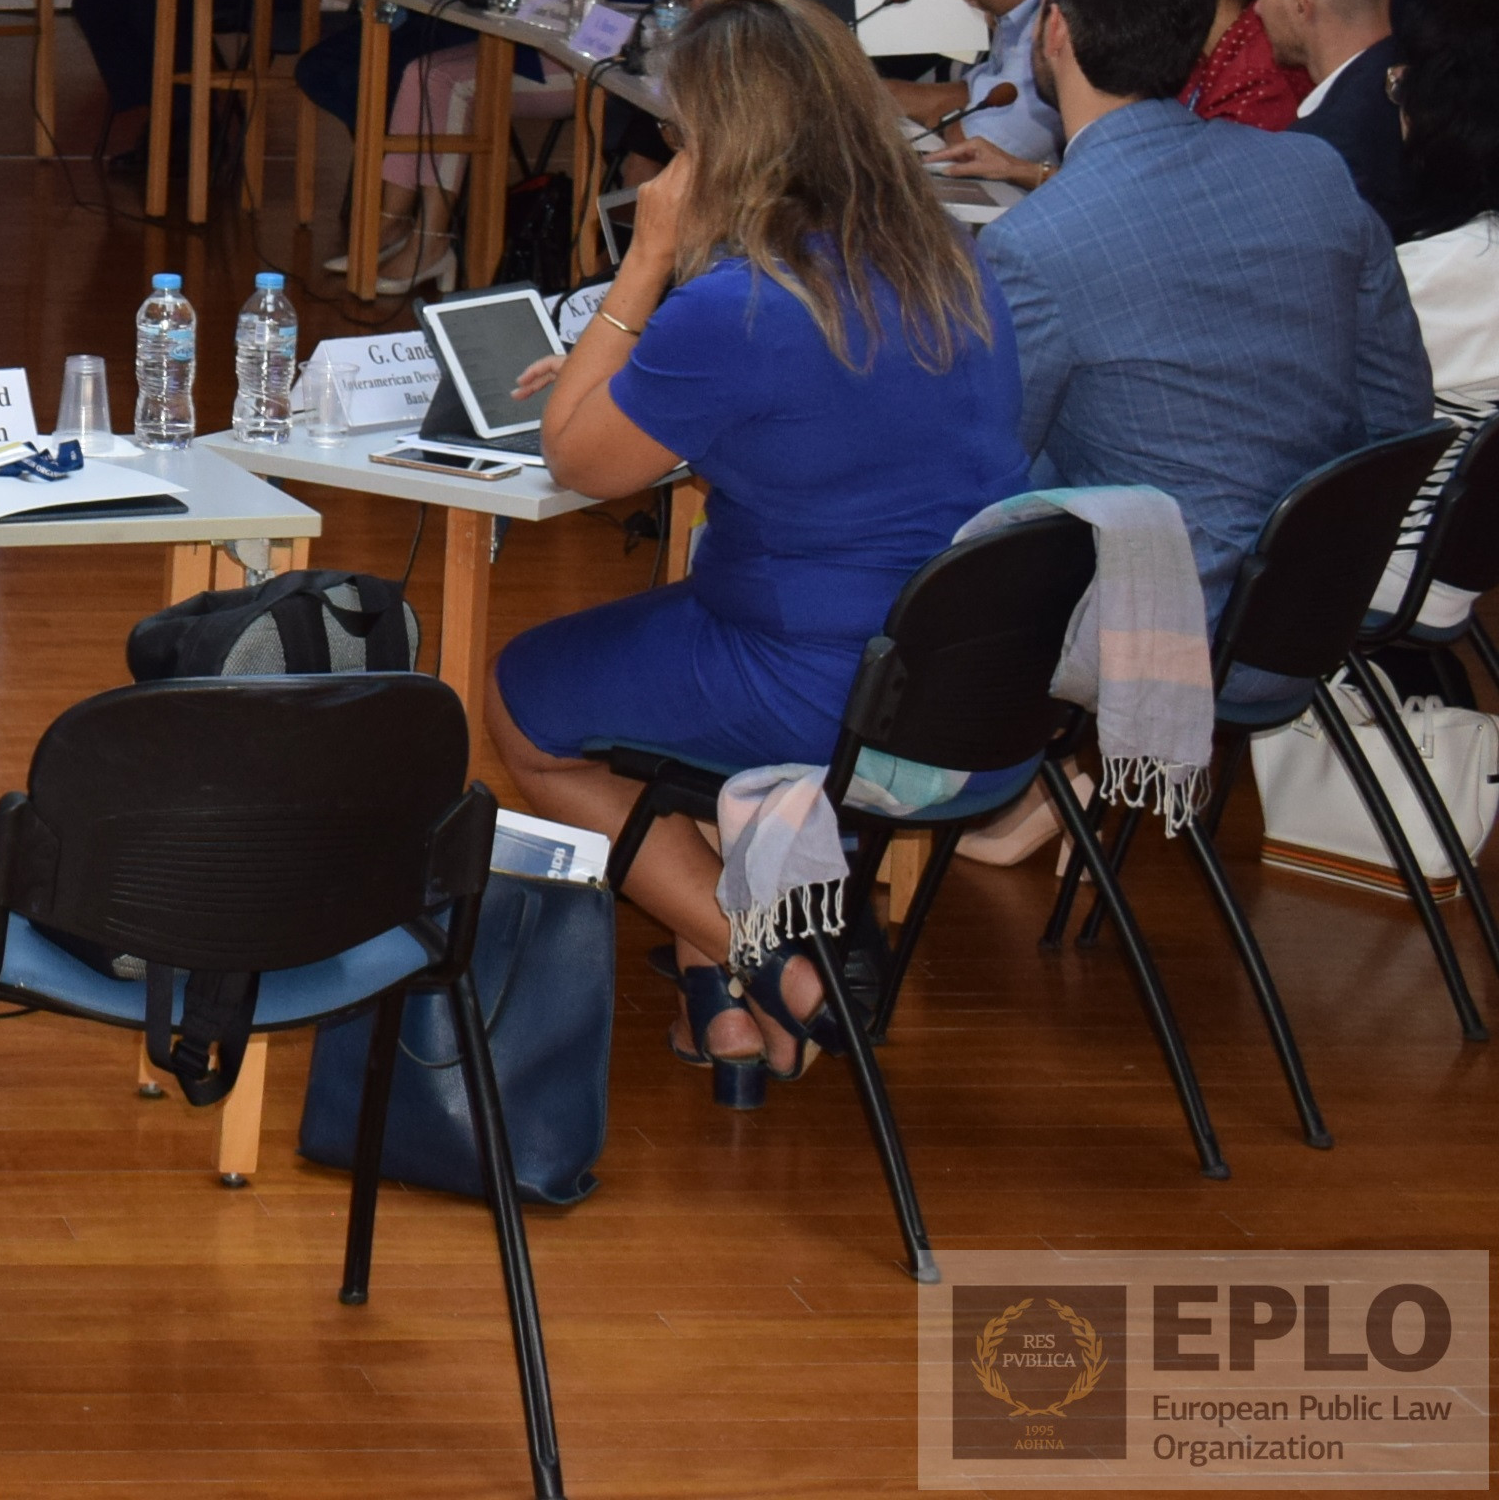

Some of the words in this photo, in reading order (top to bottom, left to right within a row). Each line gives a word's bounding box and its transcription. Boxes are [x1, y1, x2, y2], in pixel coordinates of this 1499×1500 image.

[367, 344, 390, 365] G.
[404, 391, 430, 406] Bank
[550, 847, 566, 871] IDB
